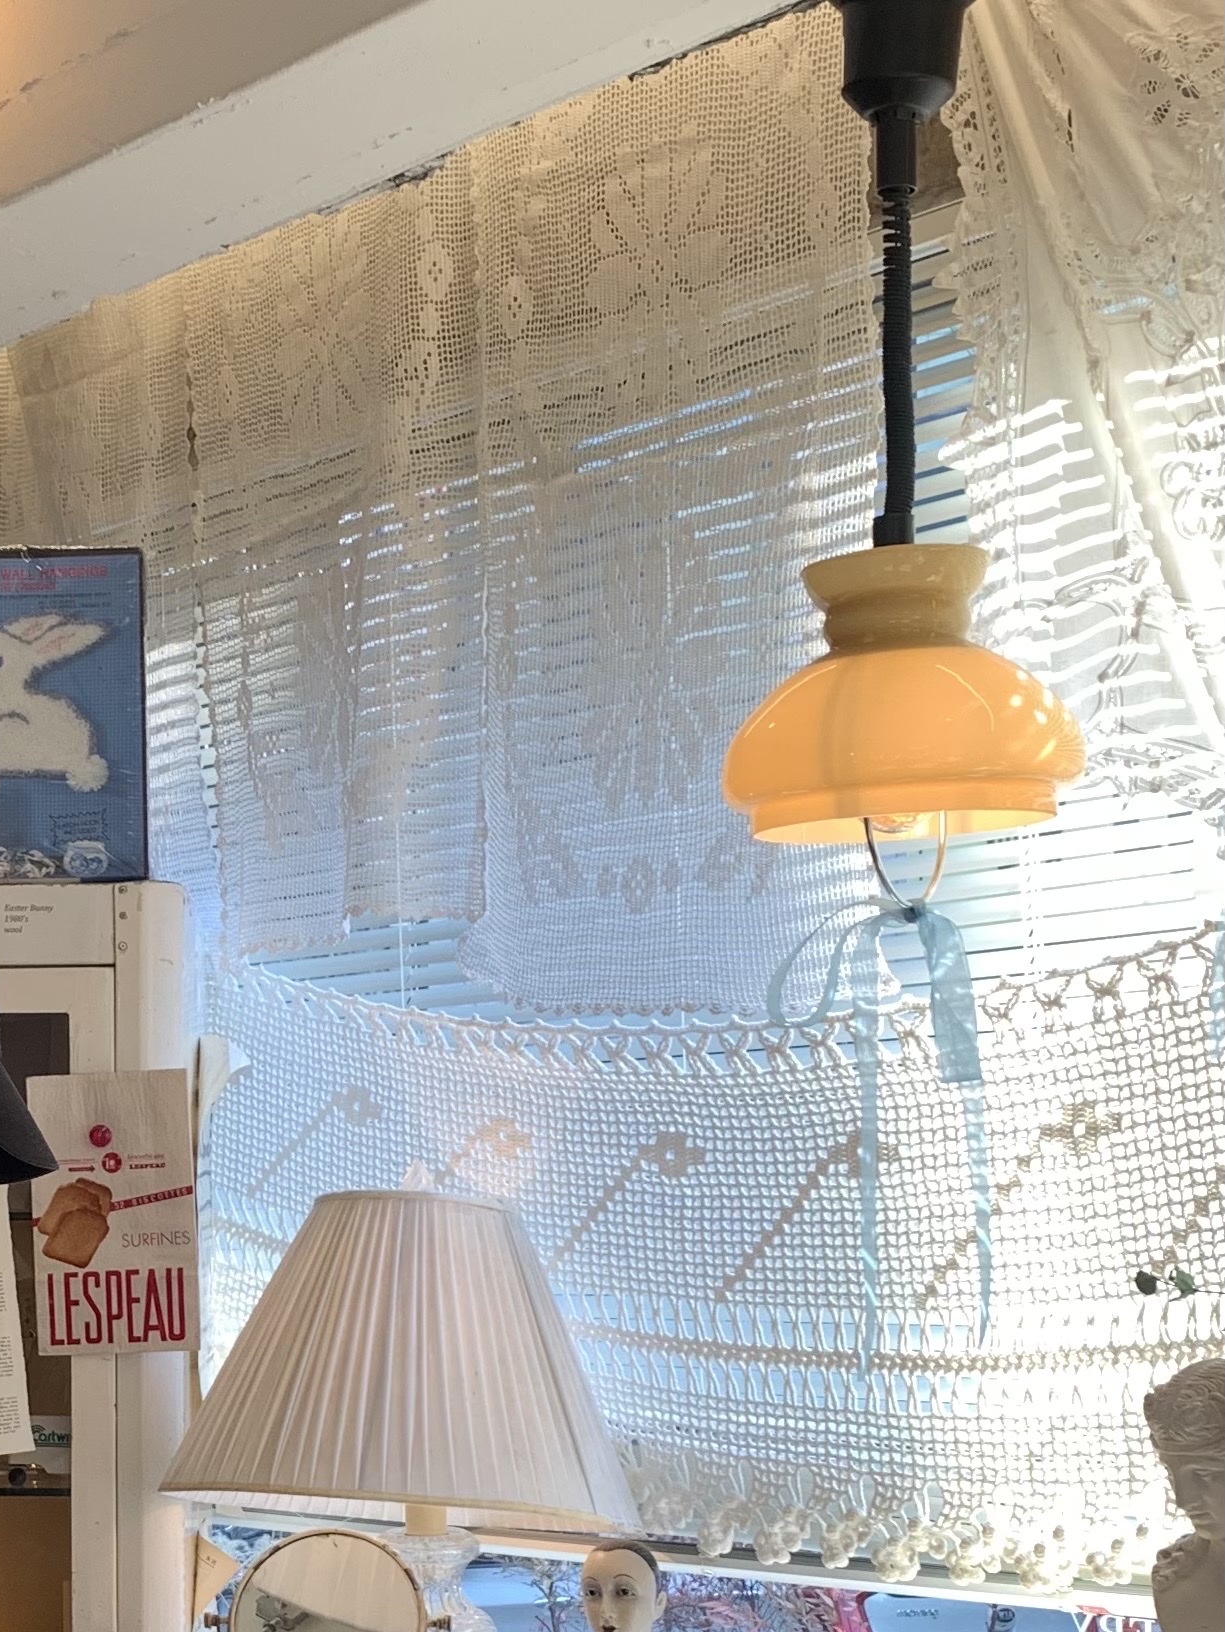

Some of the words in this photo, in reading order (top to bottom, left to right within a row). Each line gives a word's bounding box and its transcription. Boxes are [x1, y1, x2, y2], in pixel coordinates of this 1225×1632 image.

[1, 568, 32, 580] WALL
[4, 904, 28, 912] Easter
[29, 904, 55, 914] Bunny
[131, 1187, 188, 1207] BISCOTTES
[121, 1230, 192, 1249] SURFINES
[47, 1267, 187, 1347] LESPEAU
